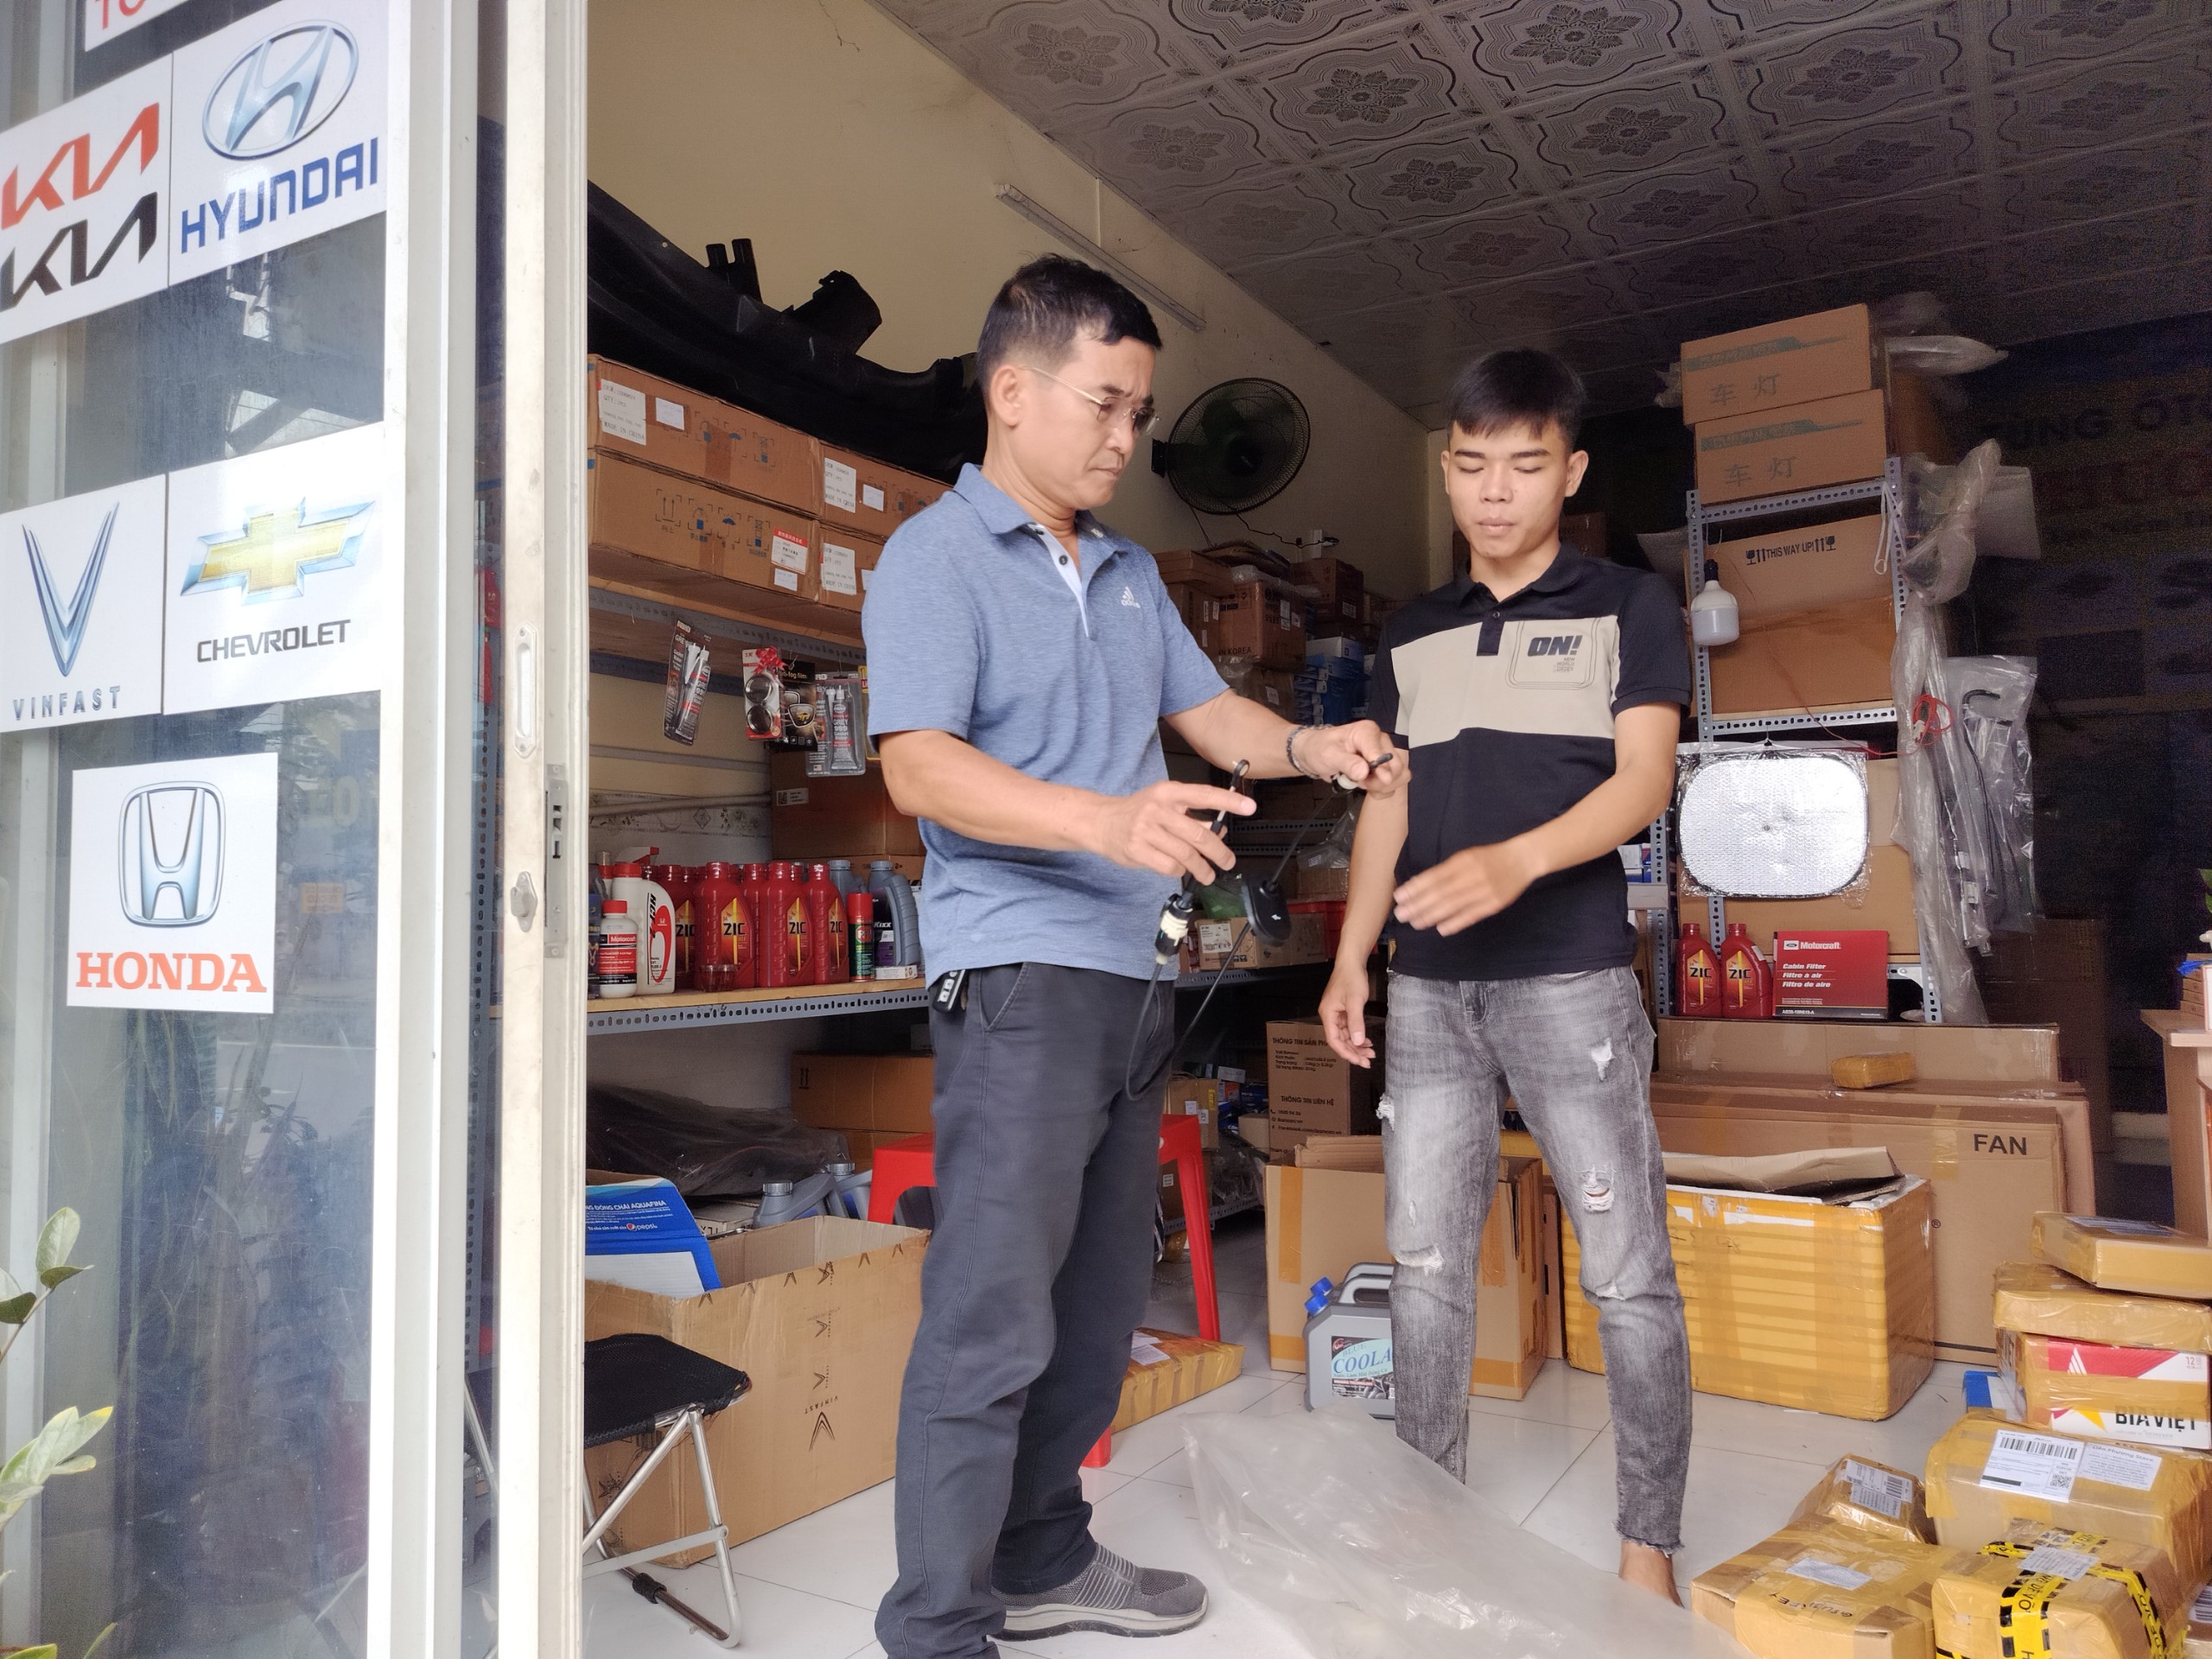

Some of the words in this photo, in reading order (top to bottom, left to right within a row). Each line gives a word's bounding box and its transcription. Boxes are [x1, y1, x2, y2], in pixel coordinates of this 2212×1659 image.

[2, 102, 160, 230] KIA
[181, 137, 379, 254] HYUNDAI
[0, 192, 158, 312] KIA
[1766, 547, 1783, 558] THIS
[1783, 543, 1800, 556] WAY
[1802, 541, 1814, 552] UP!
[197, 619, 351, 664] CHEVROLET
[1527, 635, 1583, 657] ON!
[13, 684, 122, 721] VINFAST
[723, 922, 746, 936] ZIC
[789, 921, 806, 935] ZIC
[830, 920, 843, 933] ZIC
[75, 951, 266, 994] HONDA
[1689, 968, 1712, 977] ZIC
[1728, 969, 1751, 979] ZIC
[1281, 1095, 1302, 1103] THÔNG
[1974, 1134, 2027, 1155] FAN
[631, 1199, 667, 1209] AQUAFINA
[1333, 1346, 1391, 1373] COOLA
[2185, 1357, 2195, 1365] 12
[804, 1395, 838, 1414] VINFAST
[2114, 1406, 2150, 1427] BIA
[2154, 1407, 2196, 1433] VIỆT
